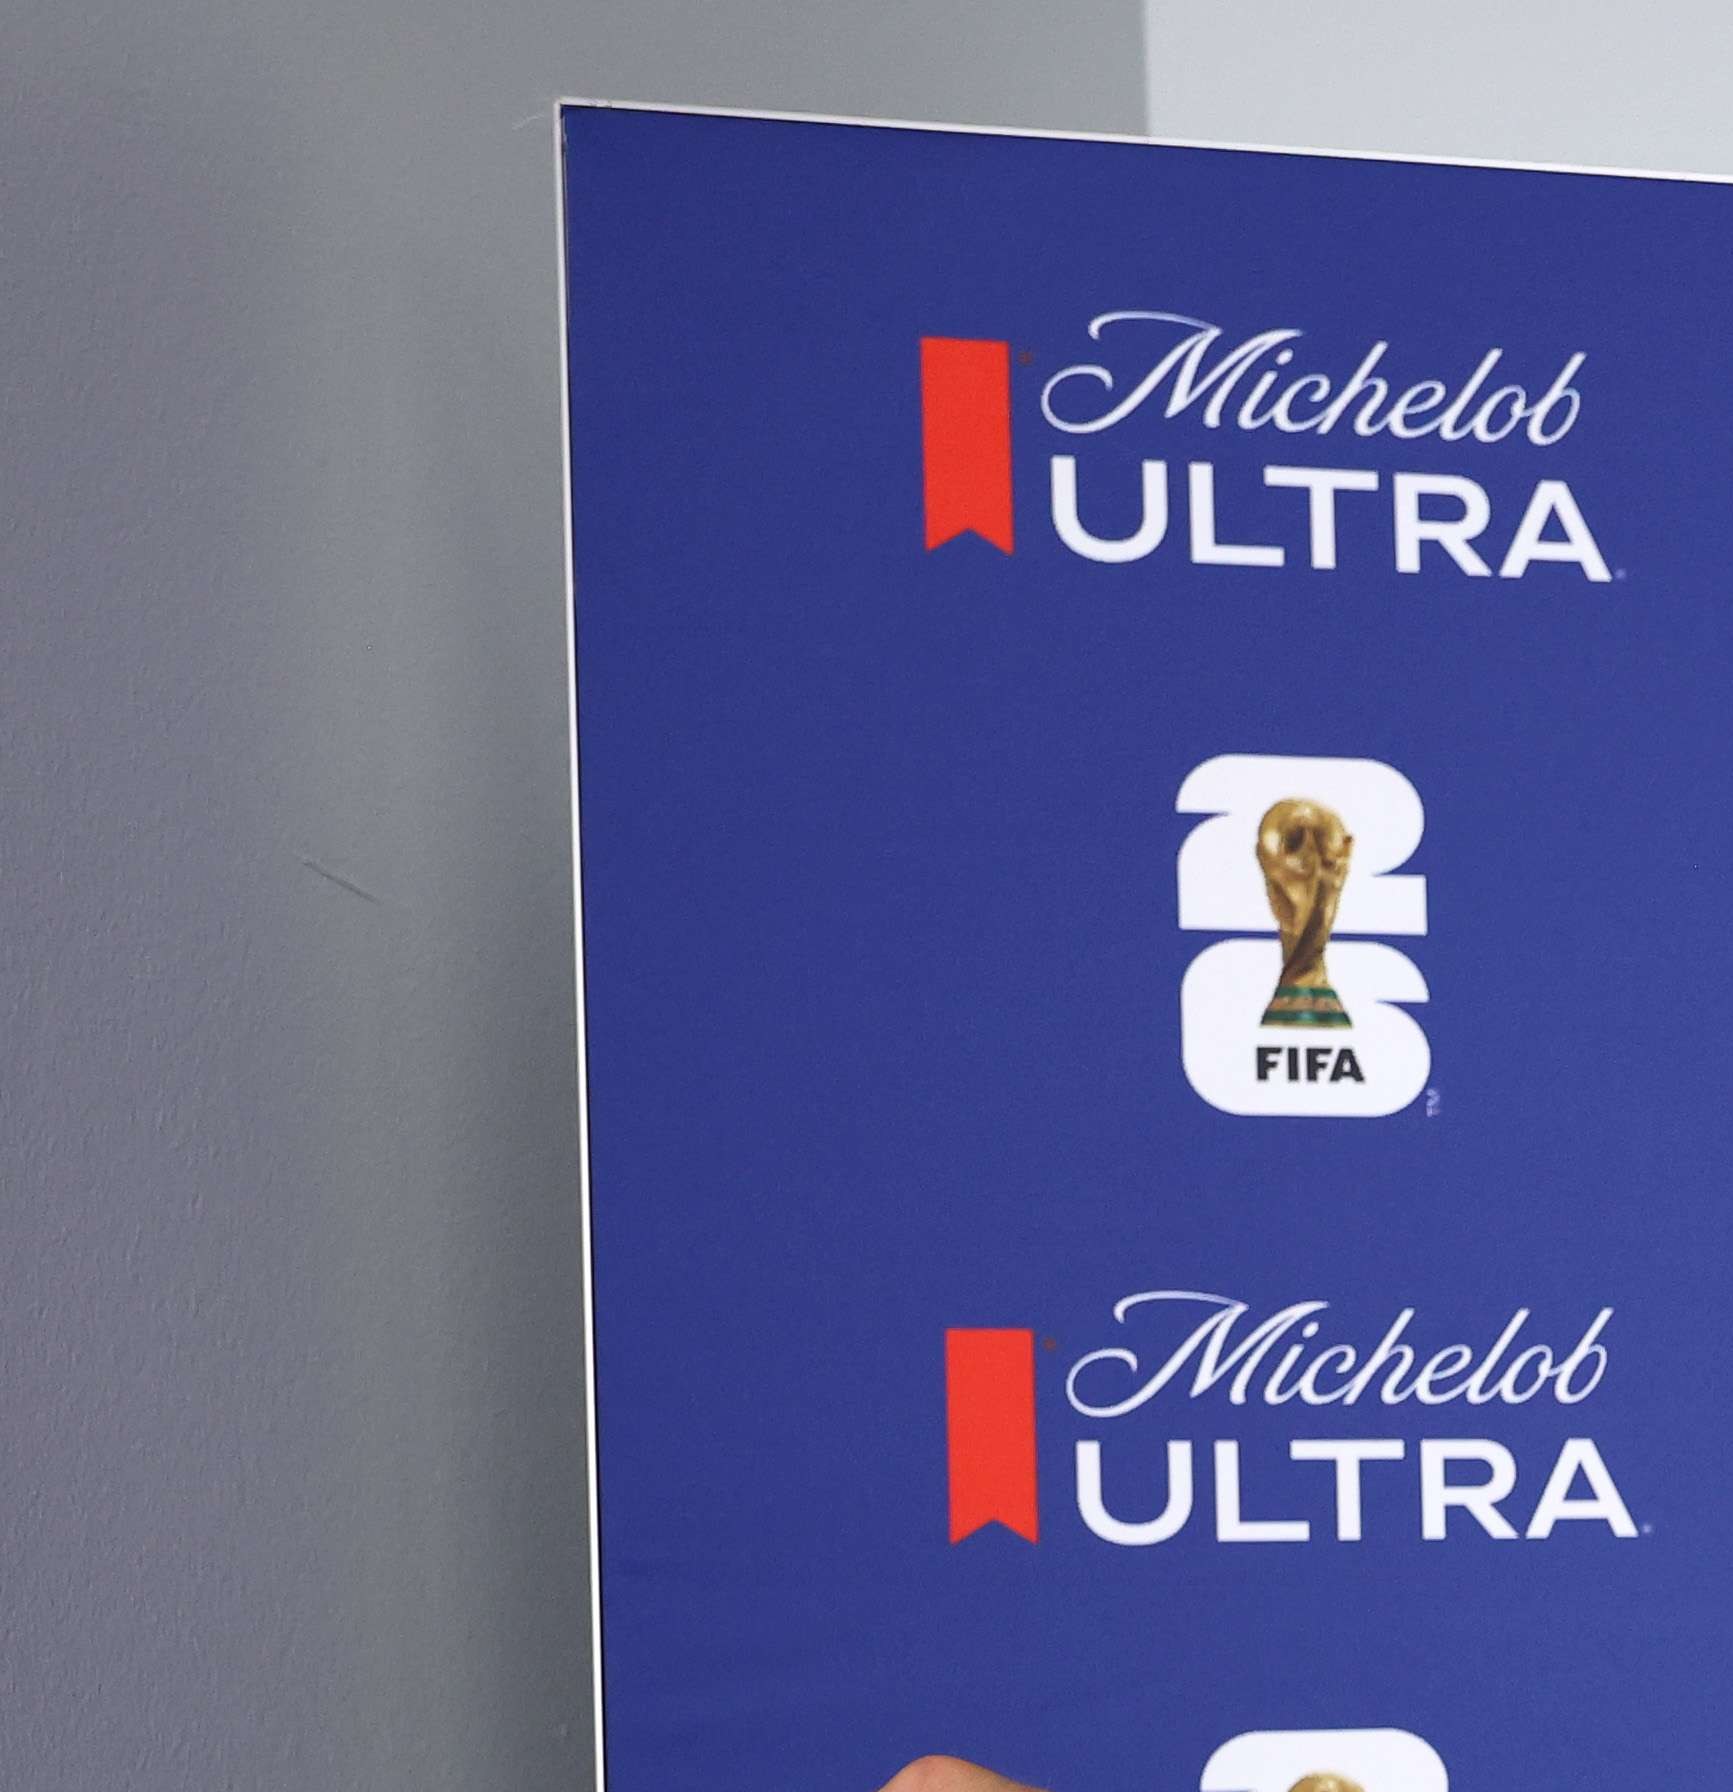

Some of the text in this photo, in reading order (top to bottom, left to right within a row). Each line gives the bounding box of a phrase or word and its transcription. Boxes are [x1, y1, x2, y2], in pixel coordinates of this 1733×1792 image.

[1040, 311, 1586, 446] Michelob
[1050, 455, 1613, 583] ULTRA
[1256, 1046, 1365, 1082] FIFA
[1066, 1289, 1614, 1418] Michelob
[1075, 1437, 1639, 1546] ULTRA
